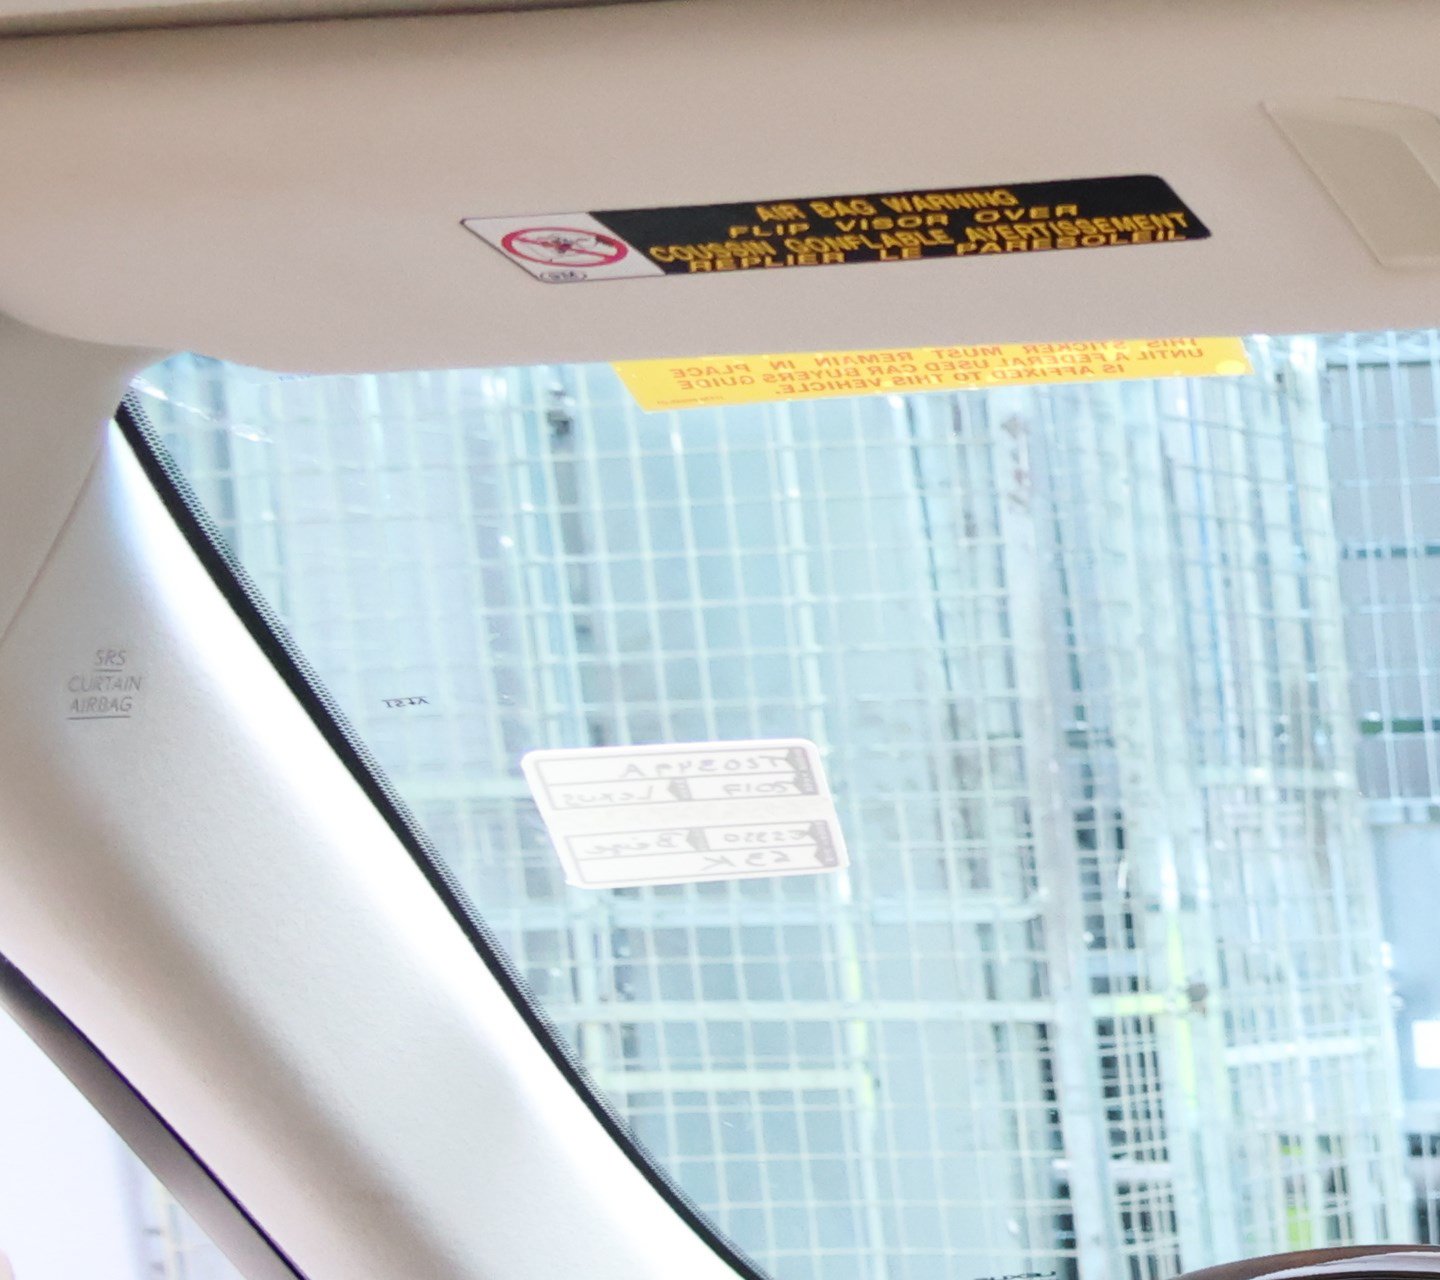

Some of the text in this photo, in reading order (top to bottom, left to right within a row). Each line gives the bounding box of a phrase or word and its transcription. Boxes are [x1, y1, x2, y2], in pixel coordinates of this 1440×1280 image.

[728, 203, 1080, 239] FLIP VISOR OVER
[755, 189, 1020, 223] AIR BAG WARNING
[649, 210, 1191, 264] COUSSIN GONFLABLE AVERTISSEMENT
[688, 229, 1190, 273] REPLIER LE PARESOLEIL
[95, 649, 127, 667] SRS
[67, 674, 143, 693] CURTAIN
[69, 695, 133, 713] AIRBAG
